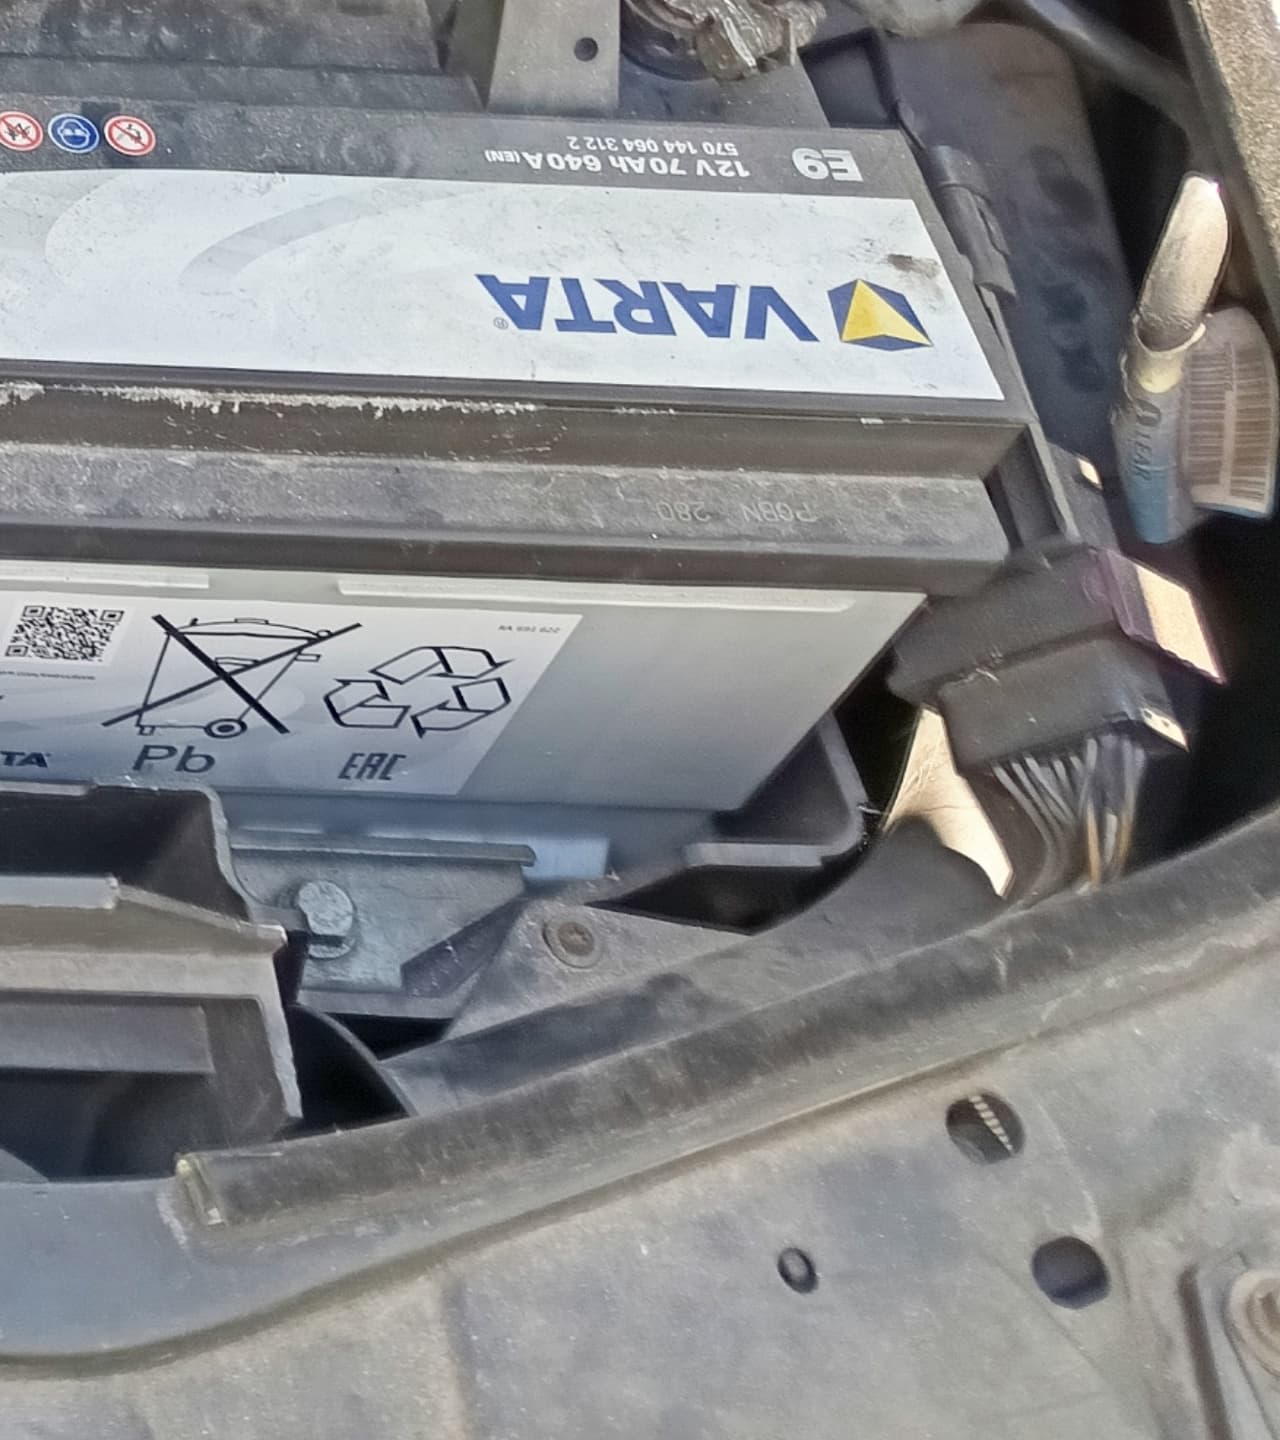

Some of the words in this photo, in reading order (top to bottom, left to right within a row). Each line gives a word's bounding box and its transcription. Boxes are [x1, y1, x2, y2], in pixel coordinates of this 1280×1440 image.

[566, 135, 579, 150] 2
[583, 136, 618, 151] 312
[623, 137, 657, 153] 064
[663, 140, 697, 155] 144
[702, 141, 736, 156] 570
[694, 159, 750, 178] 12V
[791, 146, 864, 182] E9
[474, 272, 820, 343] VARTA
[132, 743, 216, 775] Pb
